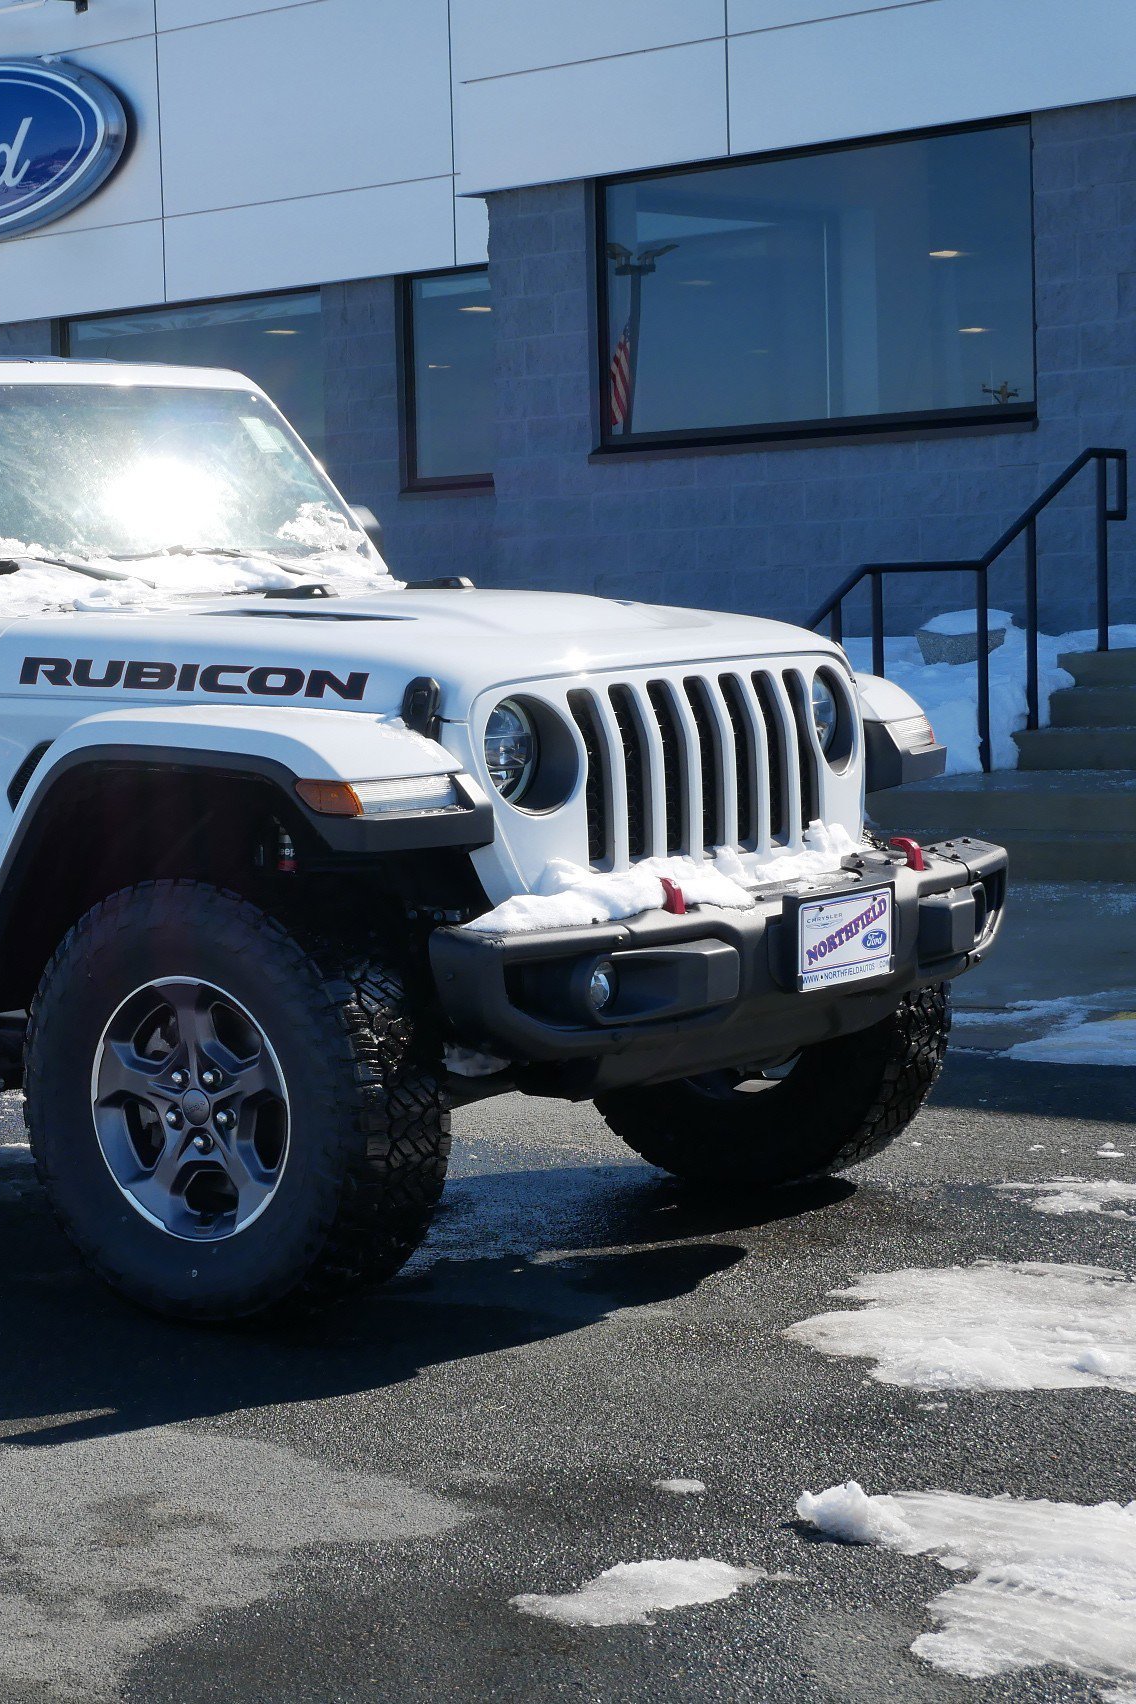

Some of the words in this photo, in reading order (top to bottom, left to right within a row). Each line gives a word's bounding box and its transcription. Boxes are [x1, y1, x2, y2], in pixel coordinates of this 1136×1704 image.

[19, 656, 370, 700] RUBICON
[805, 897, 887, 966] NORTHFIELD
[806, 912, 843, 924] CHRYSLER
[865, 931, 883, 947] Ford
